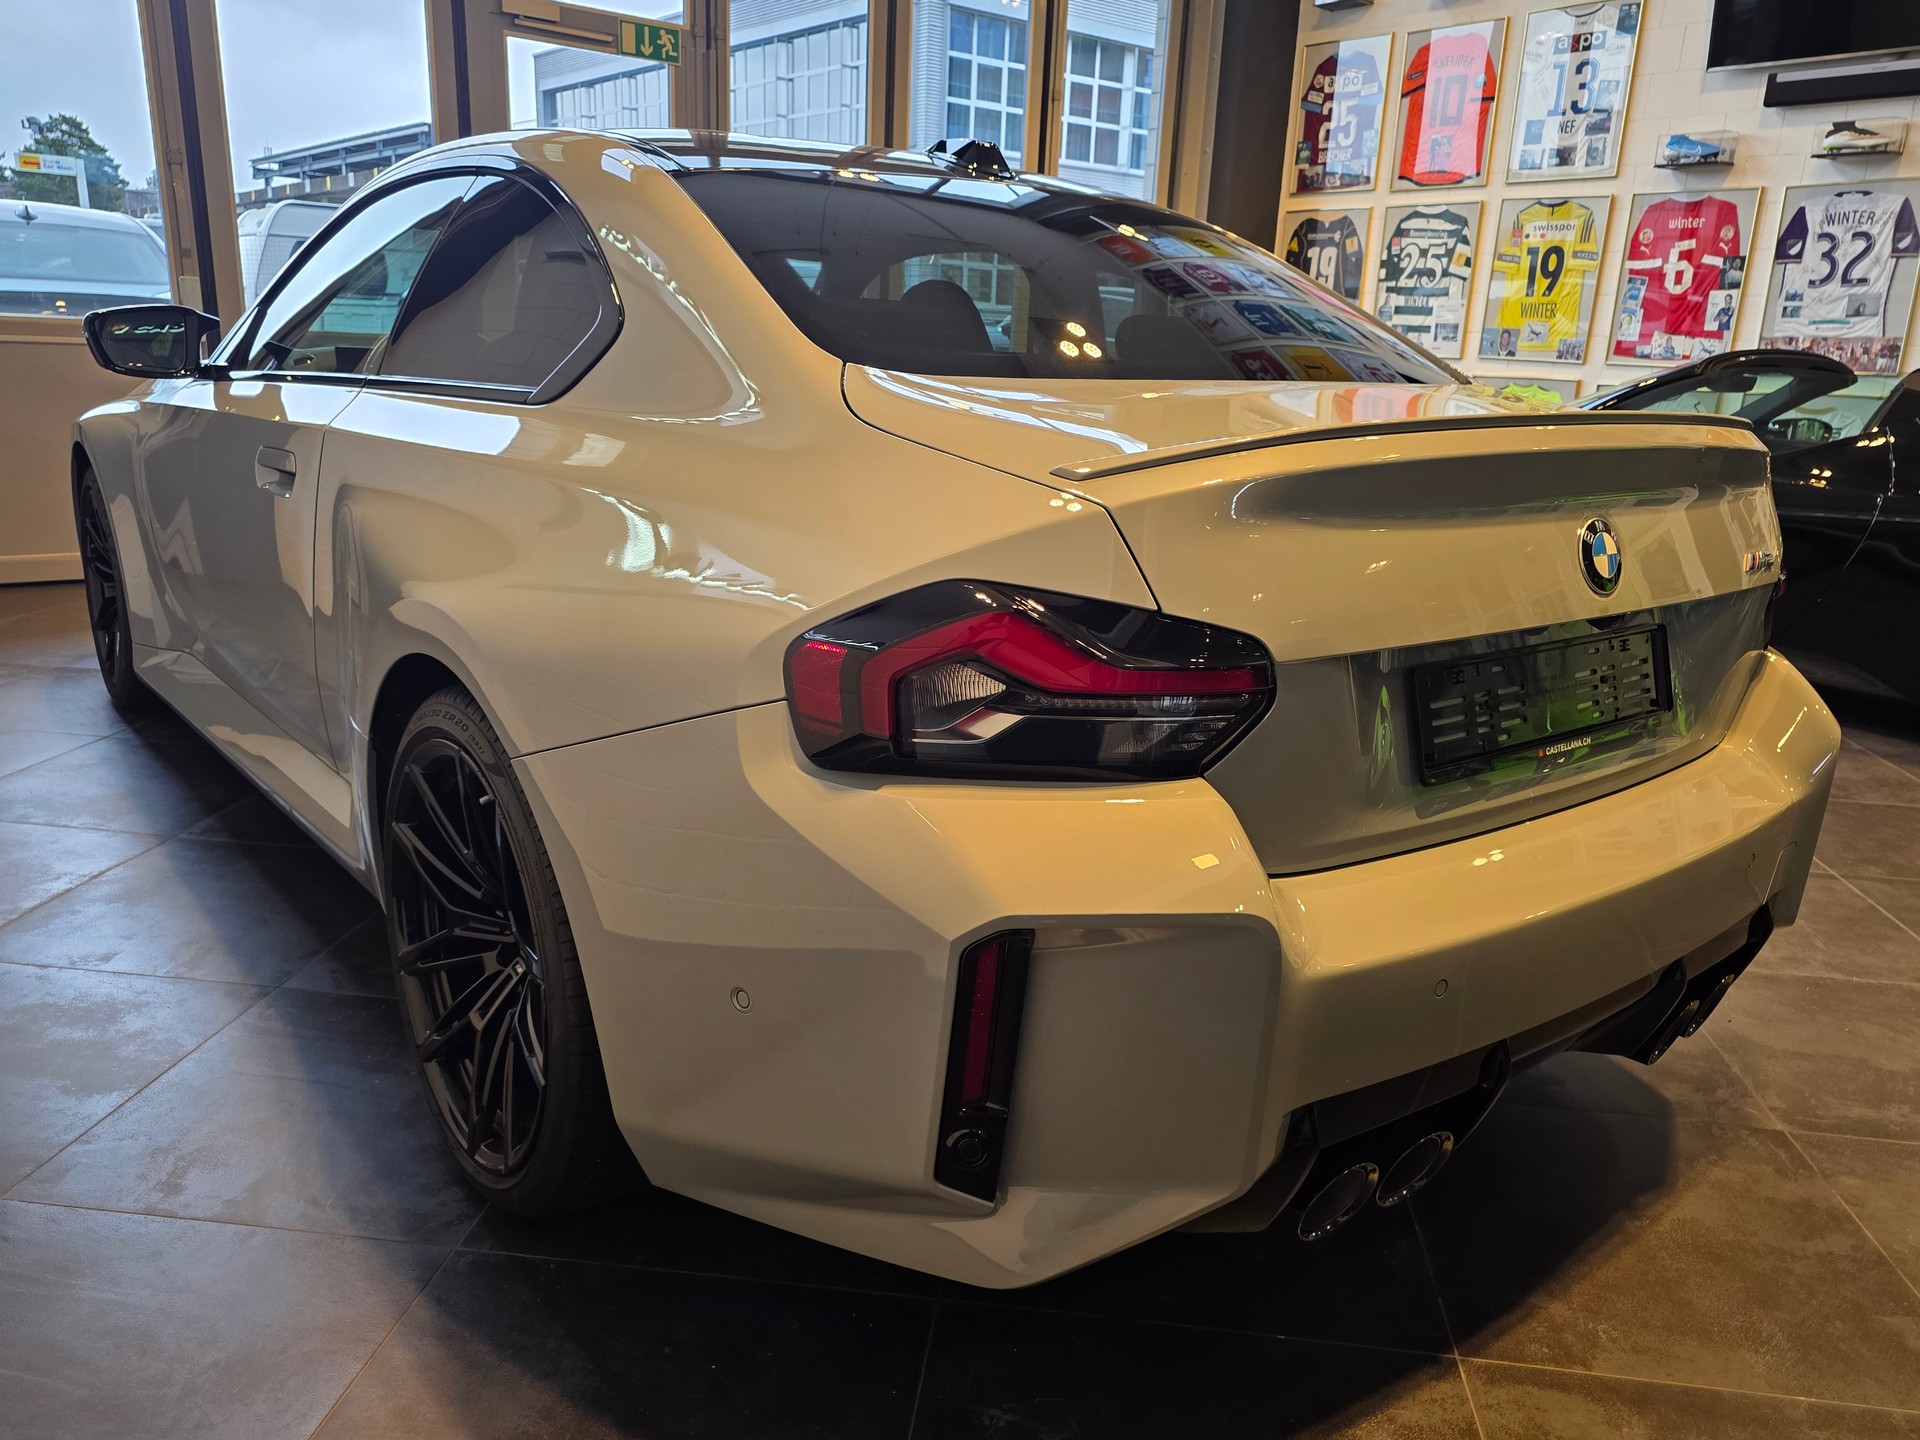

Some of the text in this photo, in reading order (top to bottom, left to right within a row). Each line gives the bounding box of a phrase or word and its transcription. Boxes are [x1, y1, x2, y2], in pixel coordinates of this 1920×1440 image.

[1430, 75, 1468, 127] 10
[1546, 58, 1601, 117] 13
[1318, 97, 1359, 148] 25
[1558, 119, 1576, 134] NEF
[1533, 221, 1577, 233] swisspor
[1669, 215, 1706, 229] winter
[1825, 209, 1876, 227] WINTER
[1307, 246, 1338, 291] 19
[1397, 242, 1448, 289] 25
[1525, 245, 1565, 298] 19
[1663, 239, 1696, 295] 6
[1807, 231, 1876, 289] 32
[1520, 302, 1558, 319] WINTER
[1545, 736, 1592, 756] CASTELLANA.CH
